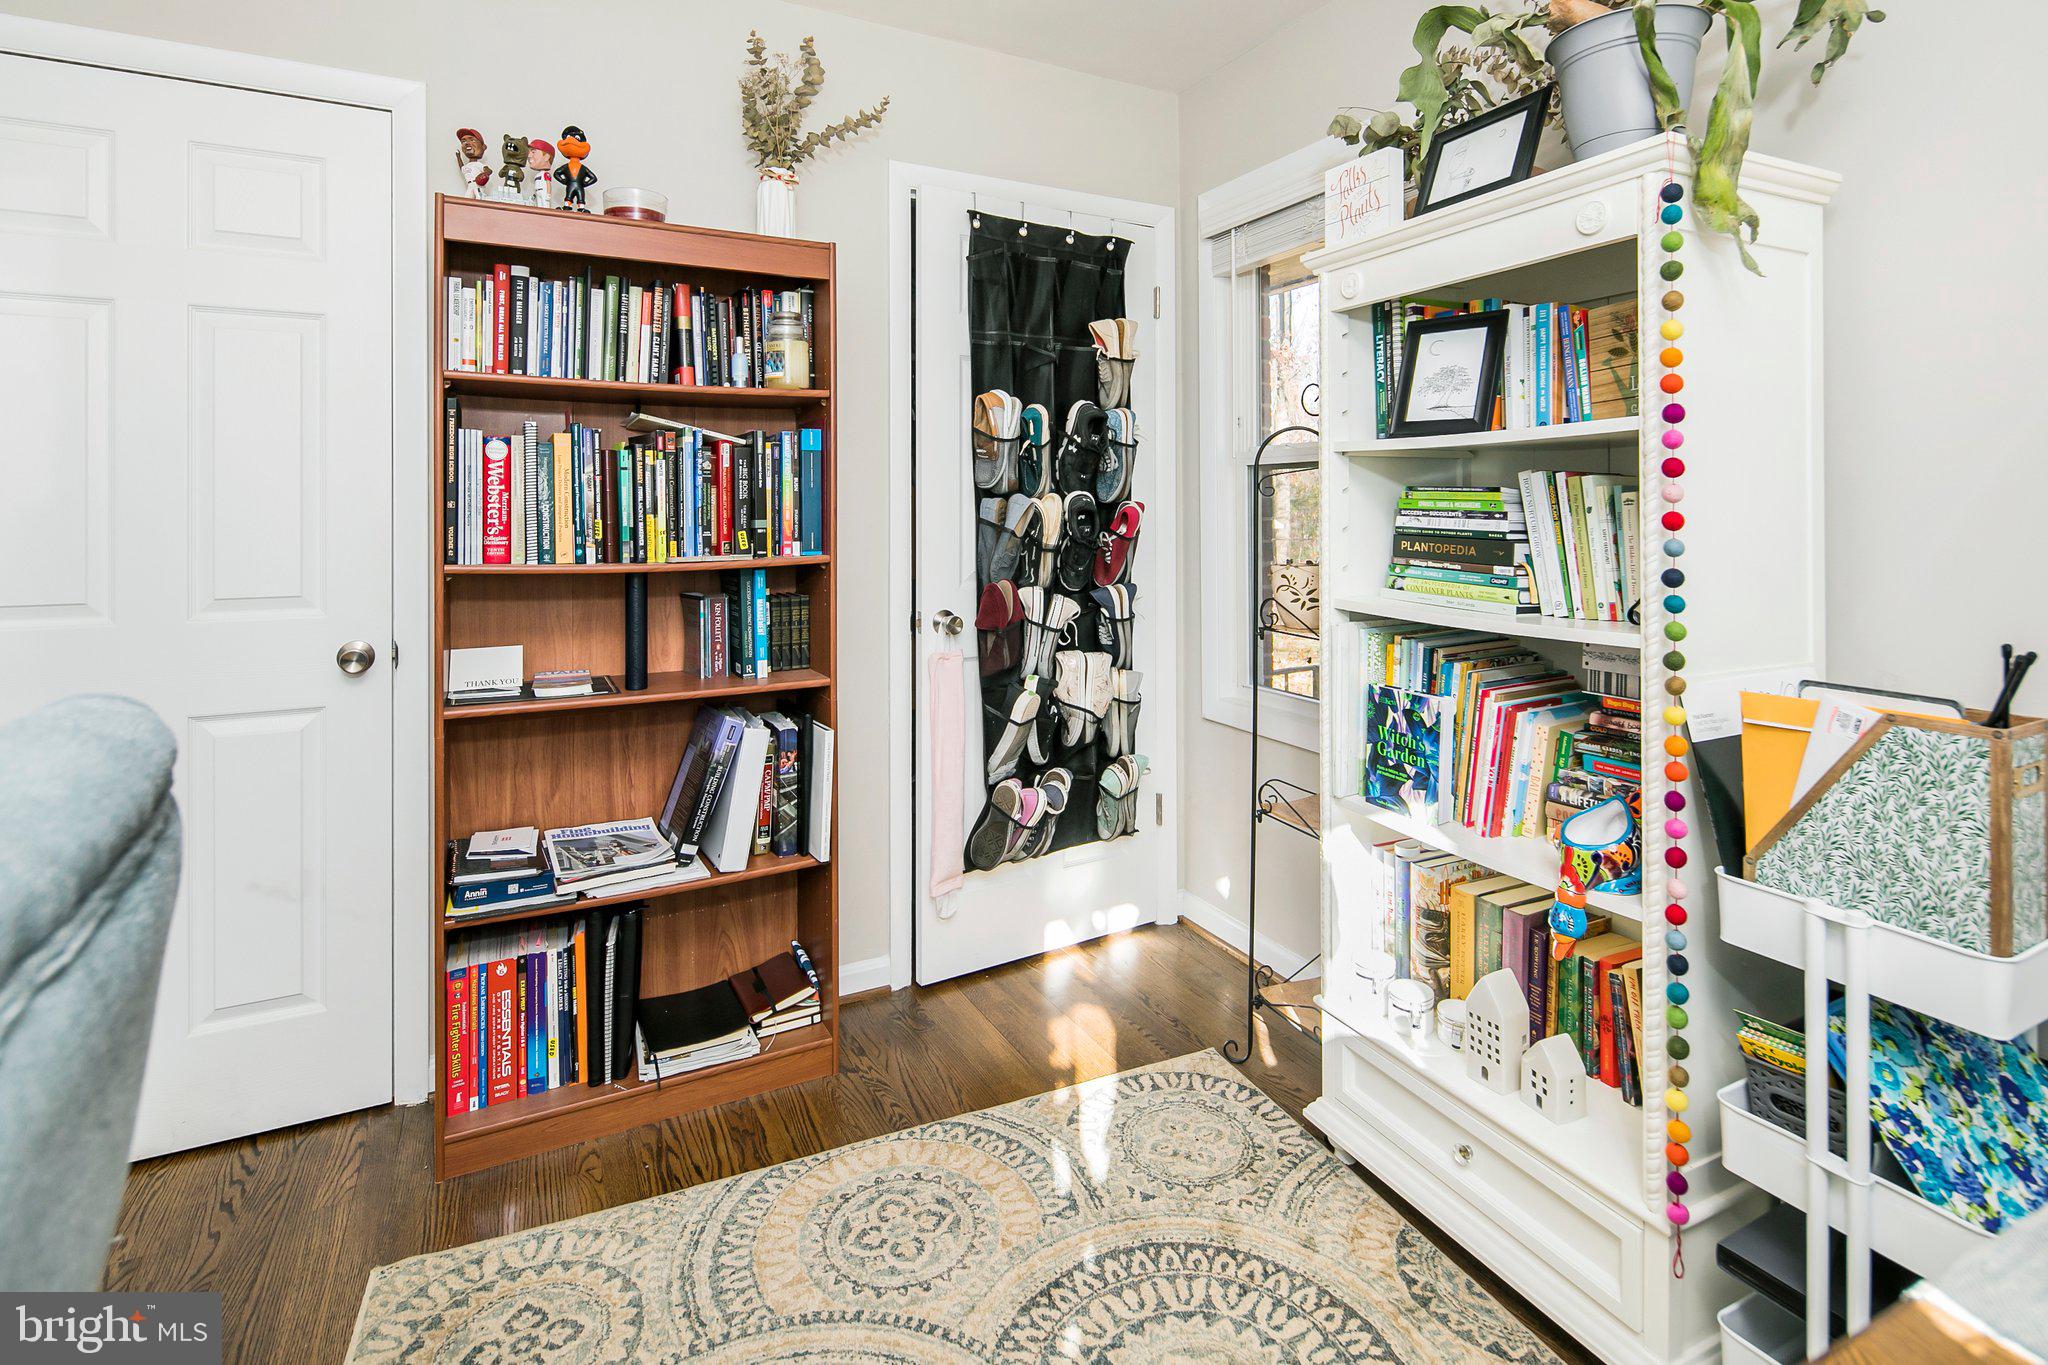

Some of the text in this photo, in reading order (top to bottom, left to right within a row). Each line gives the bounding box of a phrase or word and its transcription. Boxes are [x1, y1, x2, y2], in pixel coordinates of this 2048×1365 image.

[498, 306, 506, 323] BREAK
[515, 300, 523, 325] MANAGER
[498, 323, 506, 334] ALL
[498, 333, 506, 344] THE
[651, 286, 663, 378] HANDCRAFTED CLINT HARP
[743, 307, 751, 348] BETHLEHEM
[498, 344, 506, 361] RULES
[1375, 333, 1385, 384] LITERACY
[1578, 358, 1591, 415] ROLLING WARRIOR
[486, 459, 505, 536] Webster's
[501, 491, 510, 525] Merriam-
[563, 468, 571, 530] Modern Construction
[1400, 509, 1463, 519] SUCCESS SUCCULENTS
[1521, 477, 1543, 561] ROOT NURTURE GROW
[1550, 504, 1559, 522] PLANT
[542, 503, 550, 551] CONSTRUCTION
[594, 520, 602, 538] USED
[1400, 540, 1478, 557] PLANTOPEDIA
[1628, 545, 1636, 563] Hidden
[1405, 584, 1474, 600] CONTAINER PLANTS
[714, 602, 722, 643] KEN FOLLETT
[756, 598, 765, 636] MANAGEMENT
[464, 676, 520, 688] THANK YOU
[1378, 724, 1427, 753] Witch's
[1376, 740, 1427, 769] Garden
[763, 769, 772, 812] CAPM/PMP
[1528, 774, 1541, 798] BALL
[692, 764, 723, 843] BUILDING CONSTRUCTION
[551, 824, 652, 841] Homebuilding
[559, 827, 593, 836] Fine
[464, 887, 488, 900] Annin
[1628, 976, 1637, 992] I'M
[1632, 1009, 1642, 1033] THEN
[449, 1003, 461, 1079] Fire Fighter Skills
[501, 989, 512, 1079] ESSENTIALS
[548, 1039, 556, 1058] USED
